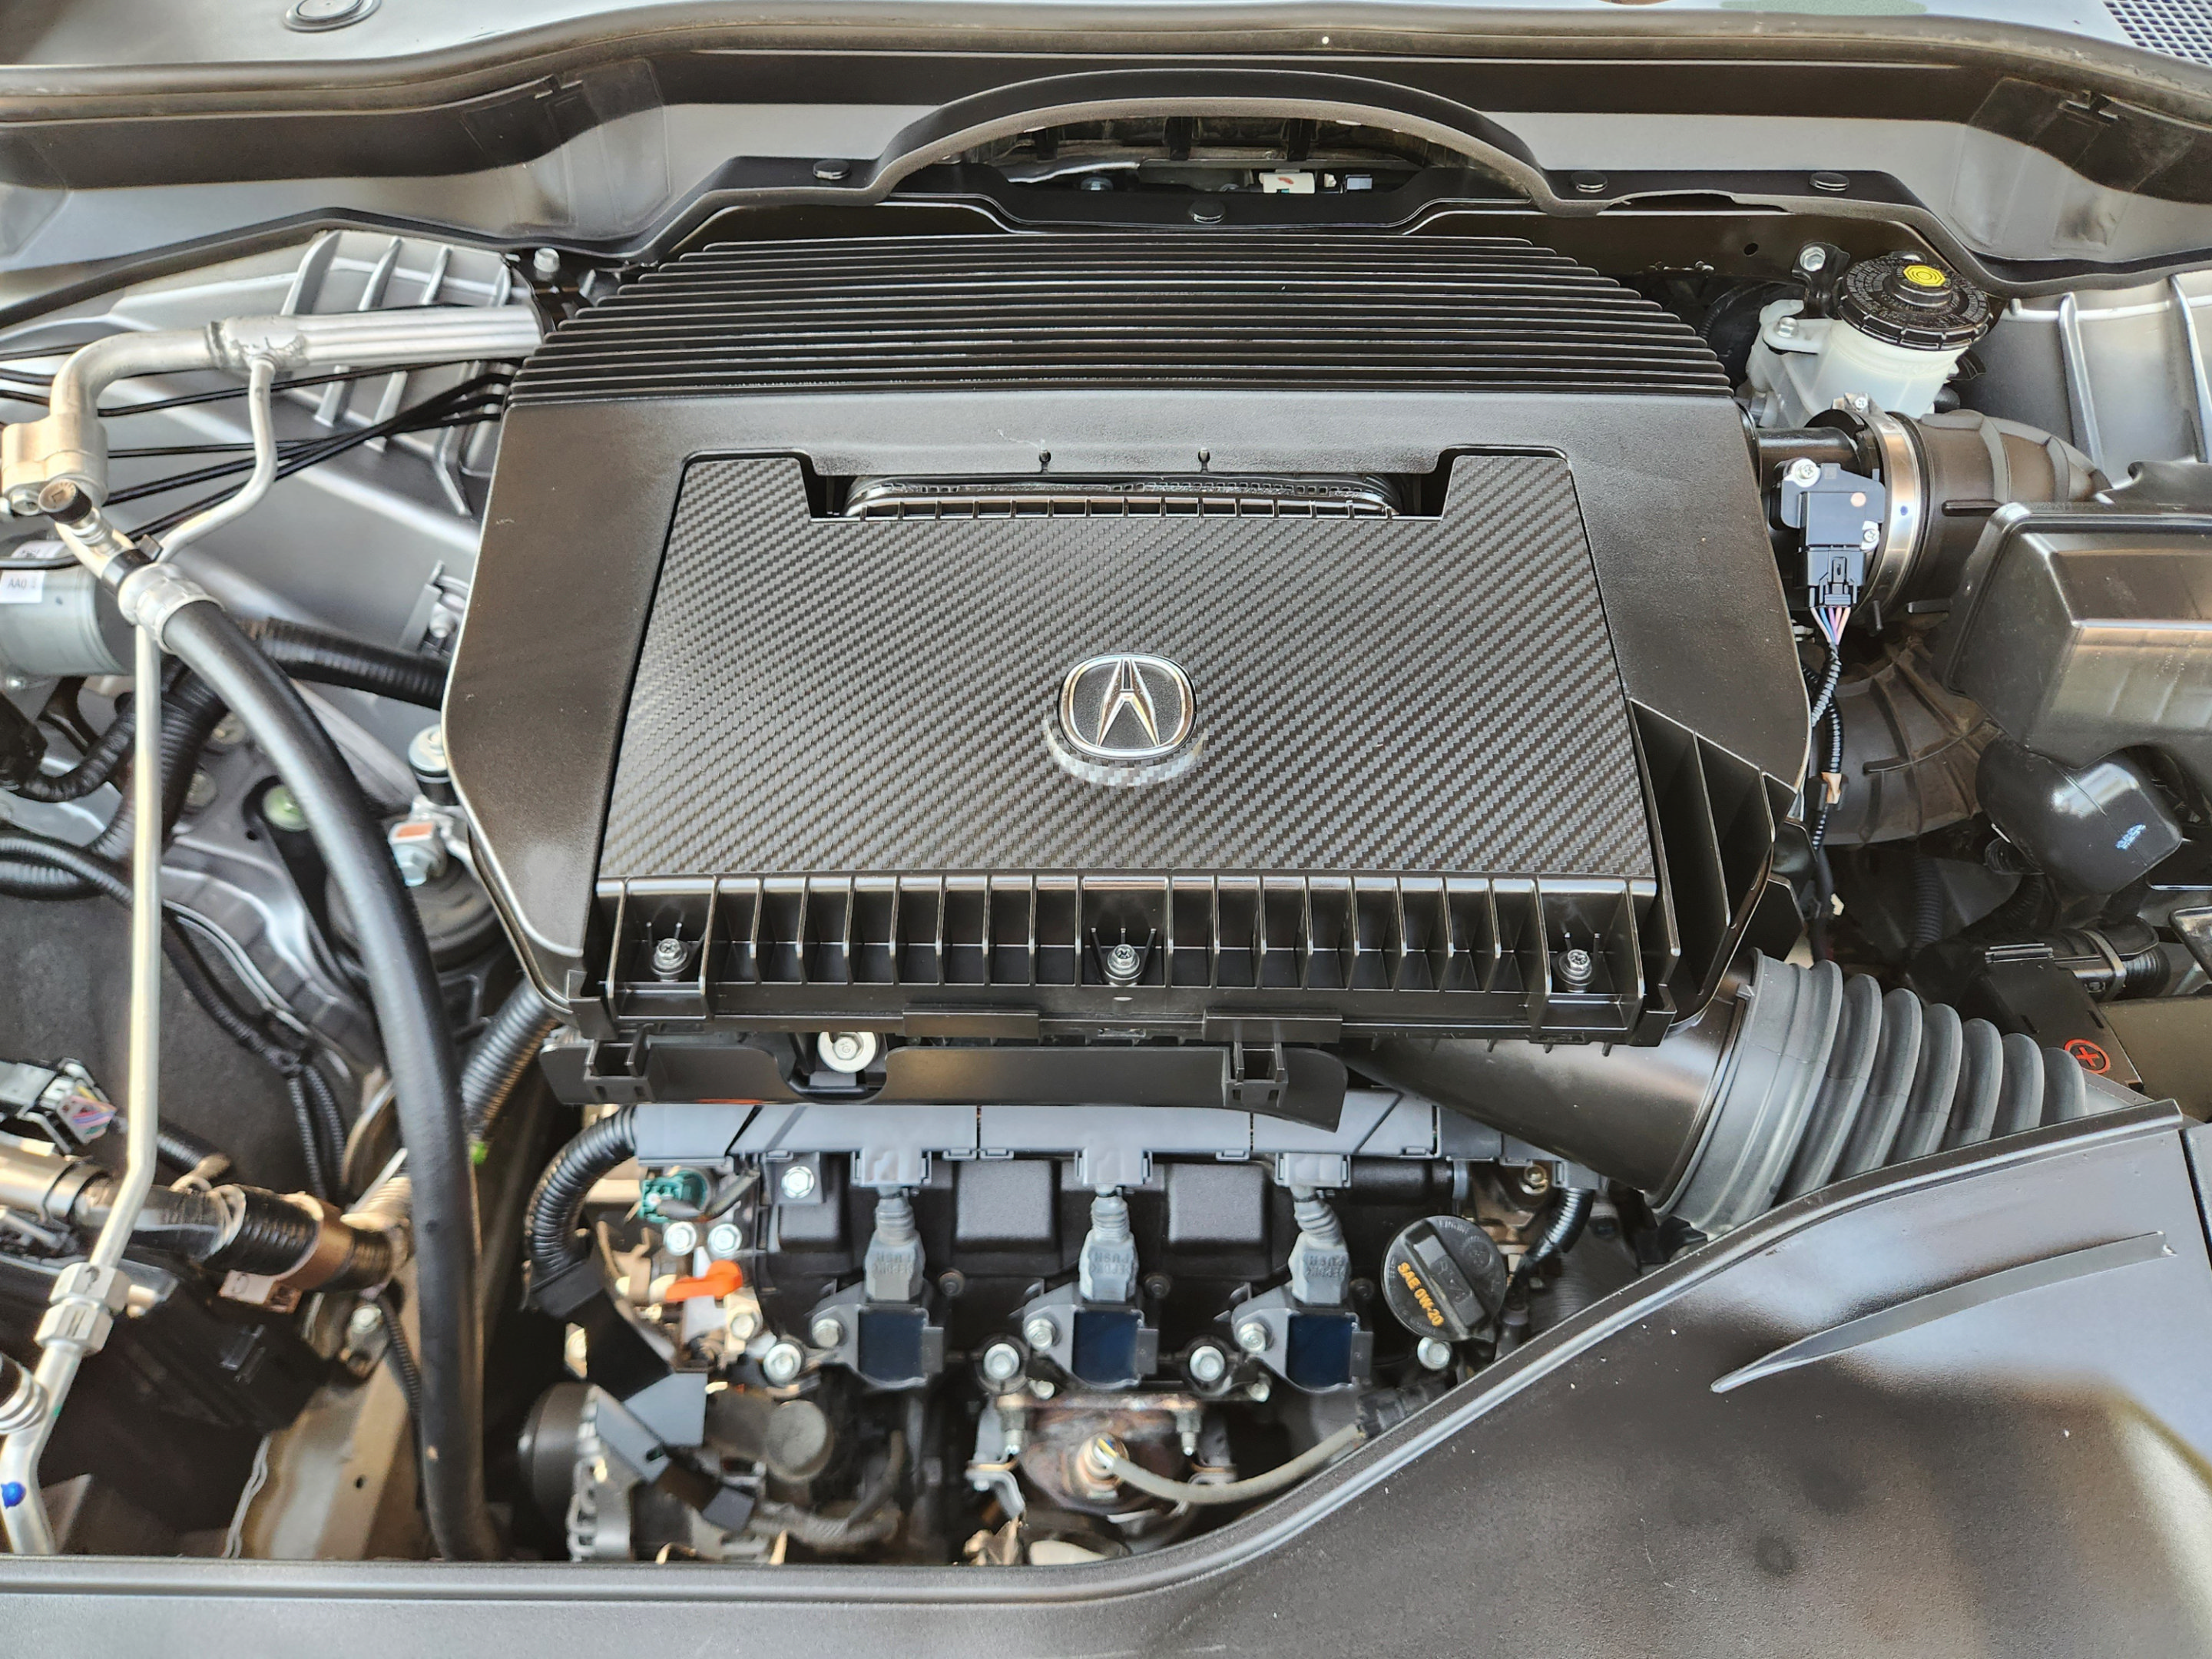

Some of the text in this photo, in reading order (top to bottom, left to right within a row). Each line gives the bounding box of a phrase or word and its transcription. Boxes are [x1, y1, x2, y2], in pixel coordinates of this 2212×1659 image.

[1094, 1252, 1129, 1264] PUSH
[1397, 1262, 1422, 1291] SAE
[1413, 1287, 1445, 1327] 0W-20
